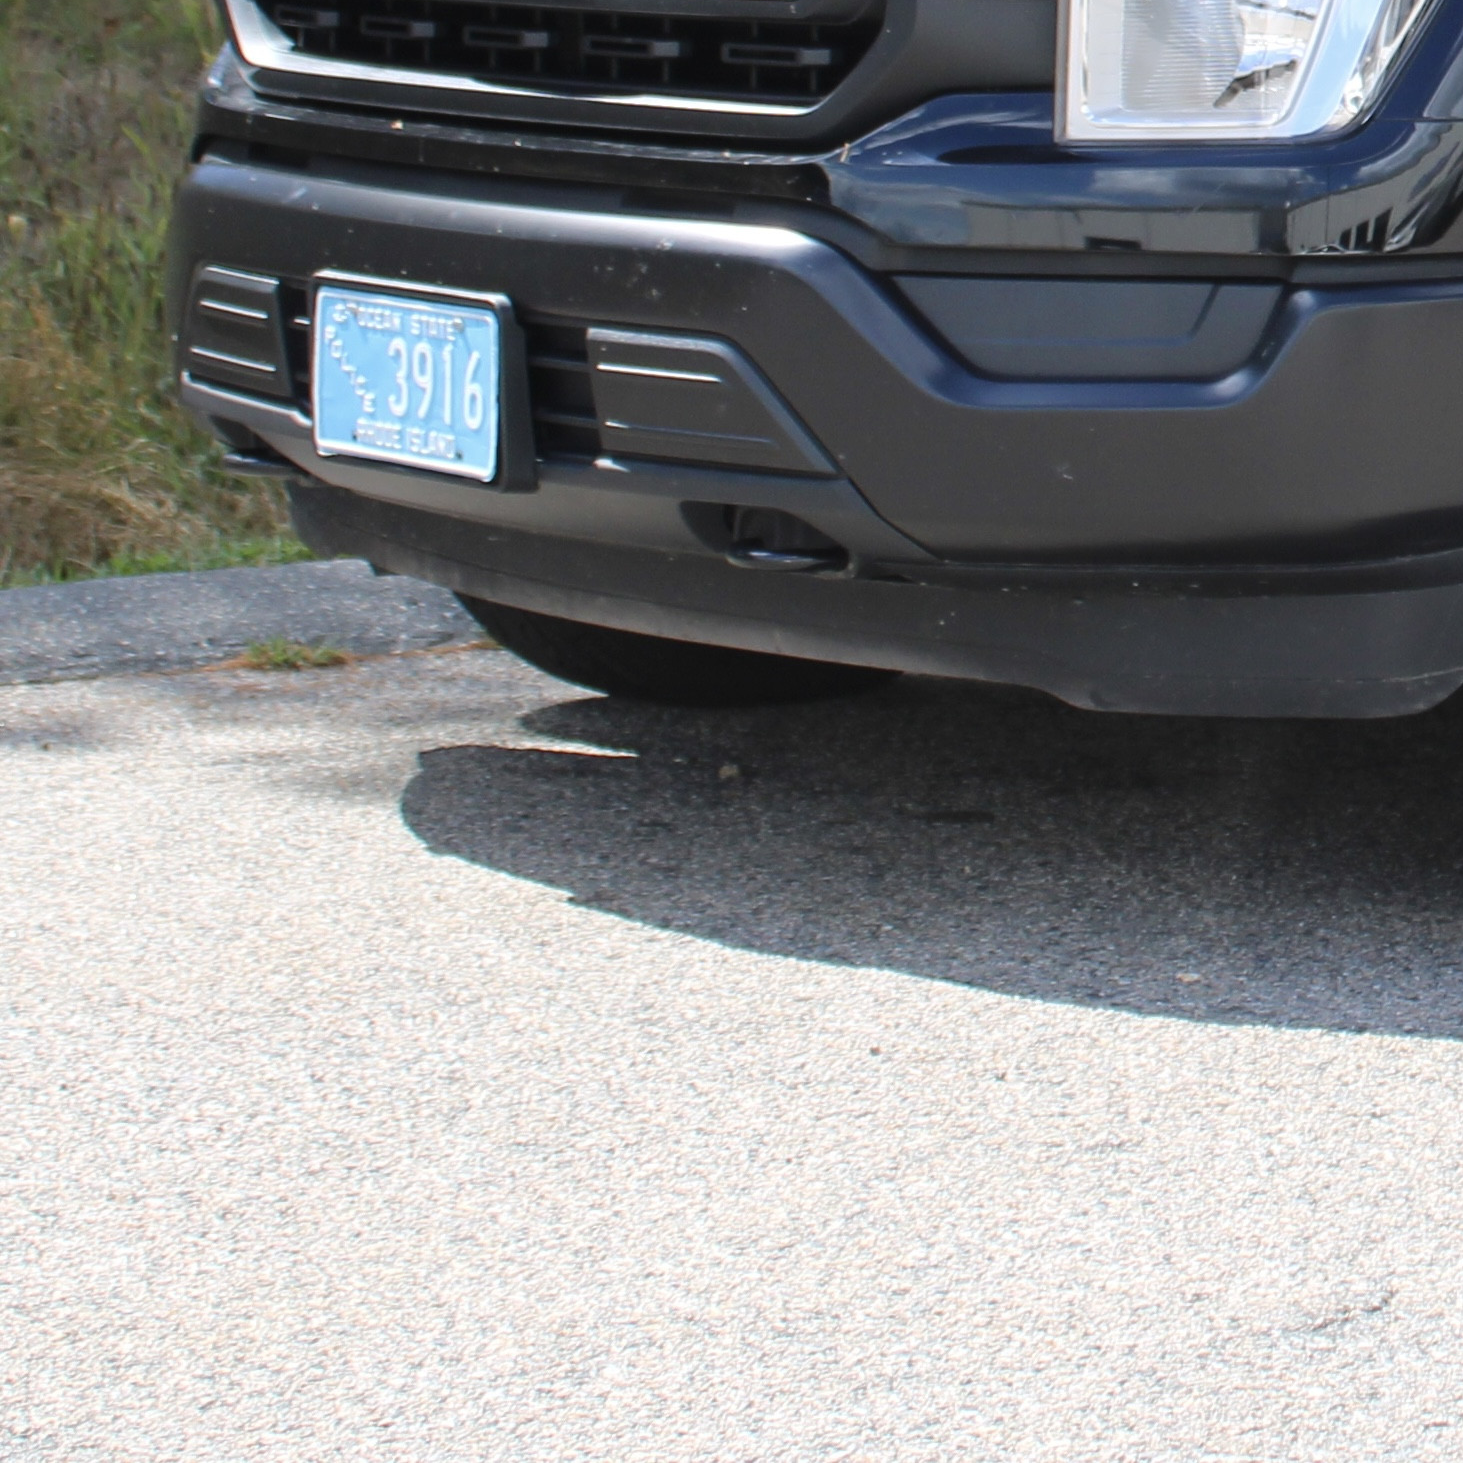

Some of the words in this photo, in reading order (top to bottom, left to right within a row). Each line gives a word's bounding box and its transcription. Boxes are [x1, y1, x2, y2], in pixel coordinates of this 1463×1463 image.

[357, 304, 402, 331] OCEAN
[410, 313, 457, 342] STATE
[323, 324, 376, 414] POLICE
[387, 337, 483, 431] 3916
[355, 417, 402, 450] RHODE
[405, 426, 457, 460] ISLAND
